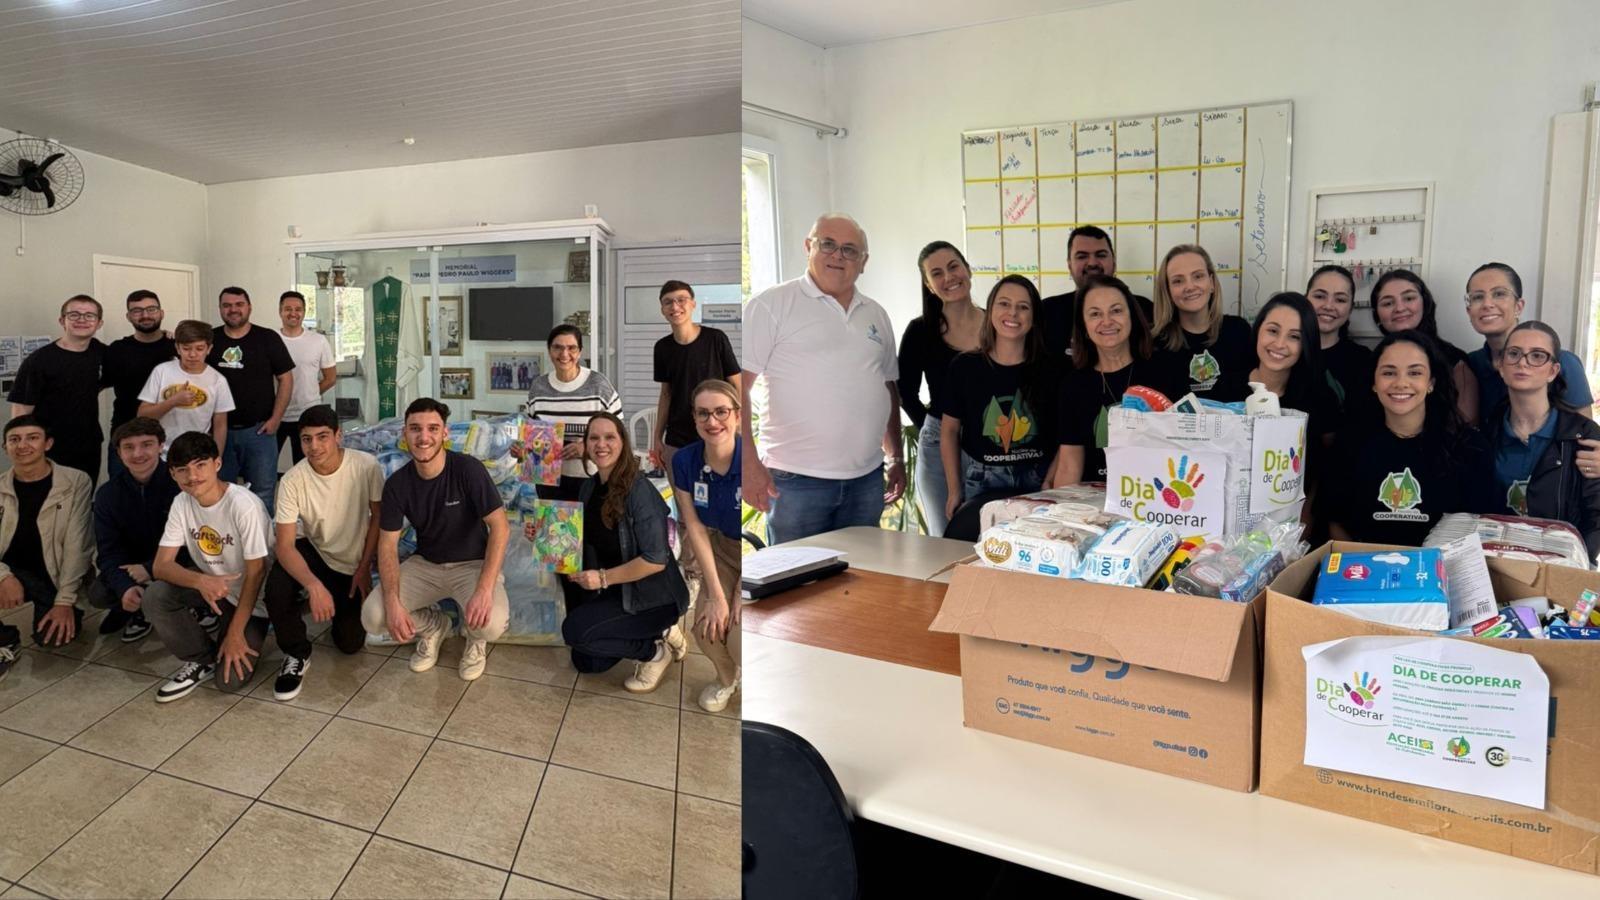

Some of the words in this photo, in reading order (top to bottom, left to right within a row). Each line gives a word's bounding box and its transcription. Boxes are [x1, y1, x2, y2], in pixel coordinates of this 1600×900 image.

[984, 452, 1043, 462] COOPERATIVAS
[1264, 449, 1289, 472] Dia
[1121, 475, 1155, 500] Dia
[1263, 472, 1273, 483] de
[1120, 498, 1132, 508] de
[1134, 501, 1207, 528] Cooperar
[1374, 513, 1428, 521] COOPERATIVAS
[1160, 533, 1173, 547] 100
[1018, 549, 1032, 563] 96
[1100, 557, 1112, 576] 100
[1393, 664, 1417, 678] DIA
[1420, 669, 1438, 682] DE
[1440, 673, 1522, 689] COOPERAR
[1008, 675, 1033, 688] Produto
[1035, 682, 1048, 691] que
[1050, 686, 1066, 694] você
[1092, 692, 1129, 707] Qualidade
[1131, 700, 1146, 711] que
[1147, 704, 1166, 714] você
[1167, 708, 1191, 719] sente.
[1316, 678, 1344, 698] Dia
[1328, 696, 1384, 721] Cooperar
